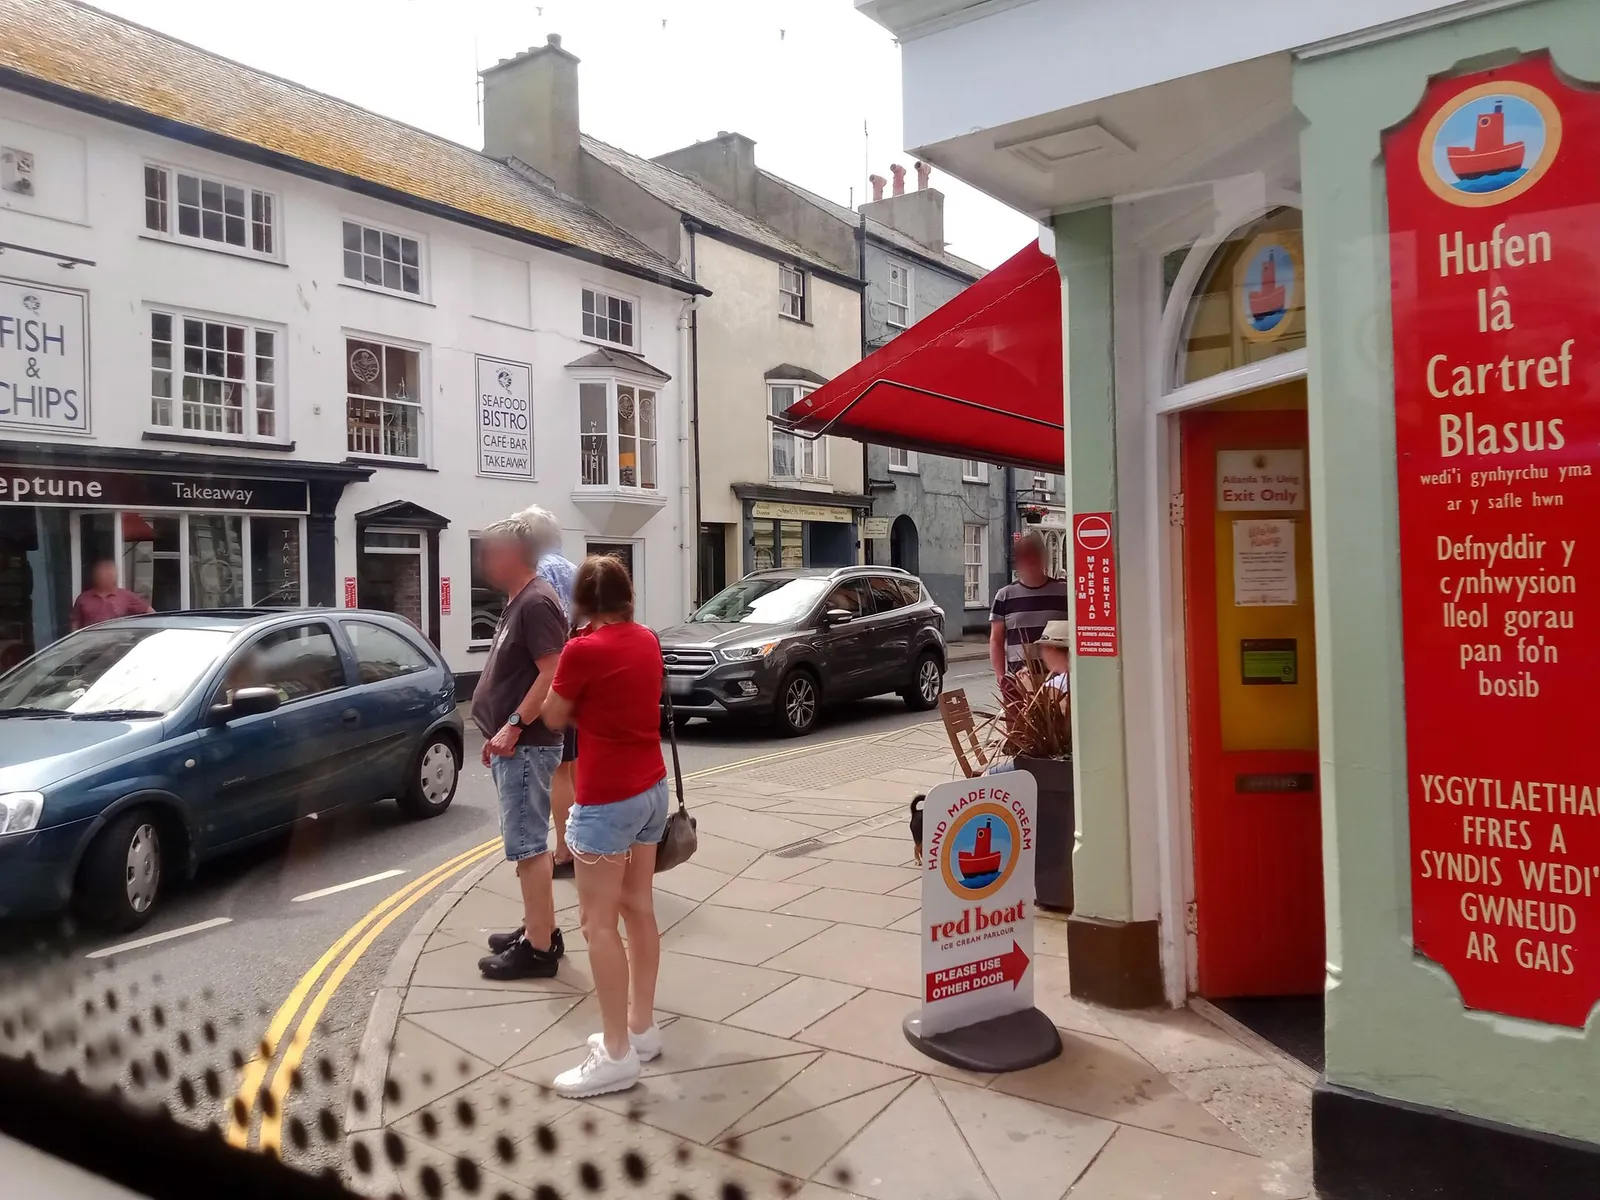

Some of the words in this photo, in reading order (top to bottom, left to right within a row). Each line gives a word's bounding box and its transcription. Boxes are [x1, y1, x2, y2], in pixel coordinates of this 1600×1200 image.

[1439, 223, 1551, 277] Hufen
[1477, 286, 1515, 333] lâ
[0, 315, 65, 356] FISH
[25, 357, 41, 380] &
[1426, 338, 1575, 399] Cartref
[0, 381, 79, 422] CHIPS
[482, 394, 527, 411] SEAFOOD
[482, 409, 528, 430] BISTRO
[1439, 411, 1566, 458] Blasus
[484, 455, 528, 469] TAKEAWAY
[1420, 467, 1462, 486] wedi'i
[1470, 464, 1549, 488] gynhyrchu
[1558, 464, 1592, 483] yma
[171, 482, 253, 505] Takeaway
[1223, 489, 1256, 502] Exit
[1260, 488, 1298, 505] Only
[1447, 499, 1462, 511] ar
[1470, 499, 1479, 515] y
[1488, 492, 1523, 510] safle
[1532, 491, 1564, 507] hwn
[1102, 558, 1110, 574] NO
[1437, 532, 1547, 569] Defnyddir
[1561, 539, 1576, 568] y
[1078, 576, 1086, 600] DIM
[1086, 556, 1096, 620] MYNEDIAD
[1442, 602, 1488, 628] lleol
[1504, 609, 1575, 637] gorau
[1460, 643, 1502, 670] pan
[1517, 635, 1559, 664] fo'n
[1478, 670, 1540, 698] bosib
[928, 821, 947, 870] HAND
[947, 788, 986, 818] MADE
[989, 787, 1011, 803] ICE
[1011, 800, 1032, 850] CREAM
[1462, 815, 1533, 851] FFRES
[1549, 823, 1567, 854] A
[1420, 850, 1503, 887] SYNDIS
[930, 907, 970, 942] red
[975, 899, 1026, 932] boat
[1460, 892, 1577, 935] GWNEUD
[941, 941, 954, 951] ICE
[956, 935, 982, 948] CREAM
[983, 926, 1015, 941] PARLOUR
[1465, 931, 1499, 964] AR
[1515, 938, 1575, 975] GAIS
[932, 979, 970, 1000] OTHER
[973, 971, 1004, 990] DOOR
[934, 964, 977, 984] PLEASE
[980, 957, 1002, 973] USE
